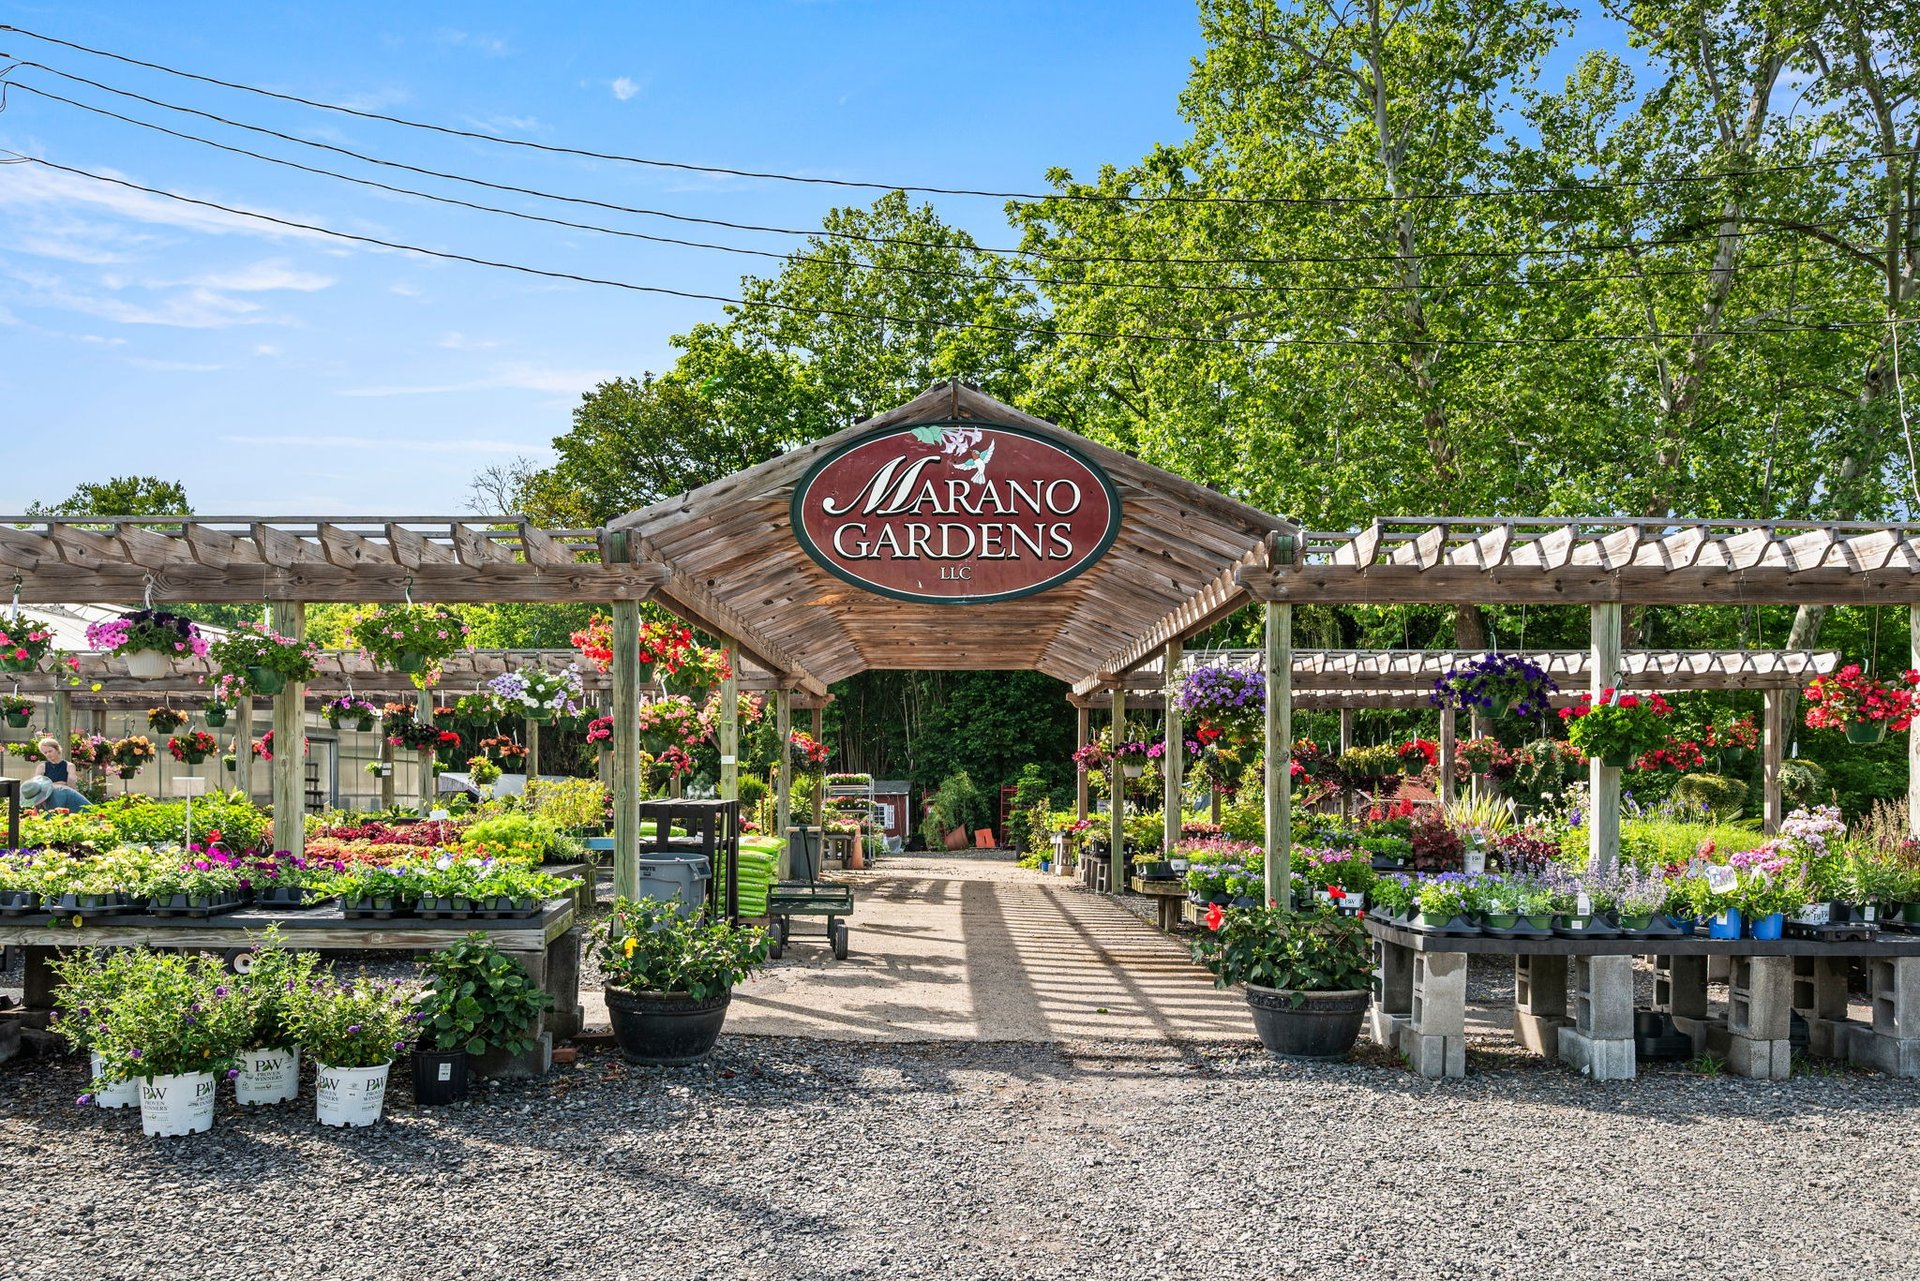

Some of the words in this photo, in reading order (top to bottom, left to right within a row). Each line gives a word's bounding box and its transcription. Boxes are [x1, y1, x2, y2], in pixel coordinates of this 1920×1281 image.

[822, 455, 1082, 515] MARANO
[833, 522, 1074, 560] GARDENS
[939, 566, 972, 581] LLC
